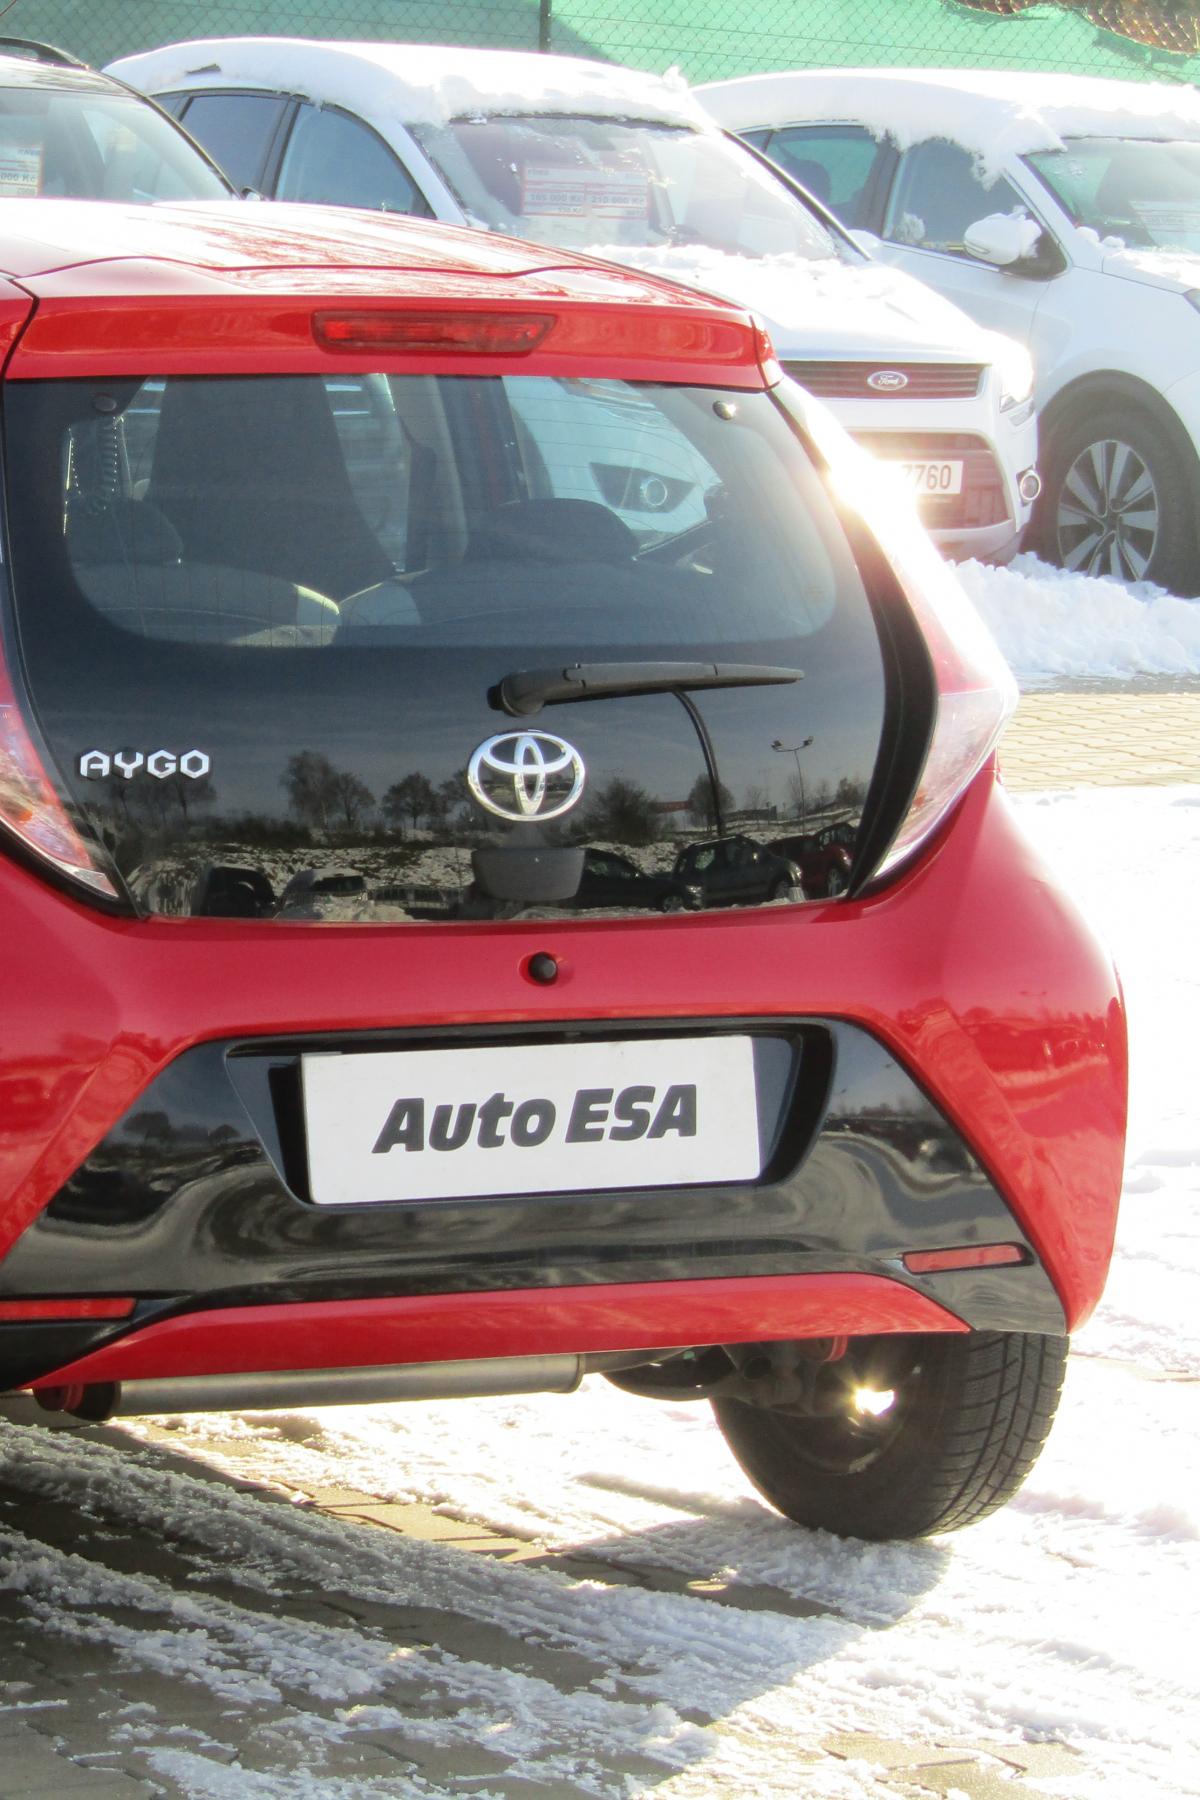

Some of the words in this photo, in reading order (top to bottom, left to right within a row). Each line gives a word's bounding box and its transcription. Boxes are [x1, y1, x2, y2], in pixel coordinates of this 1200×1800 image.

[79, 749, 210, 779] AYGO
[371, 1092, 556, 1154] Auto
[564, 1083, 697, 1144] ESA
